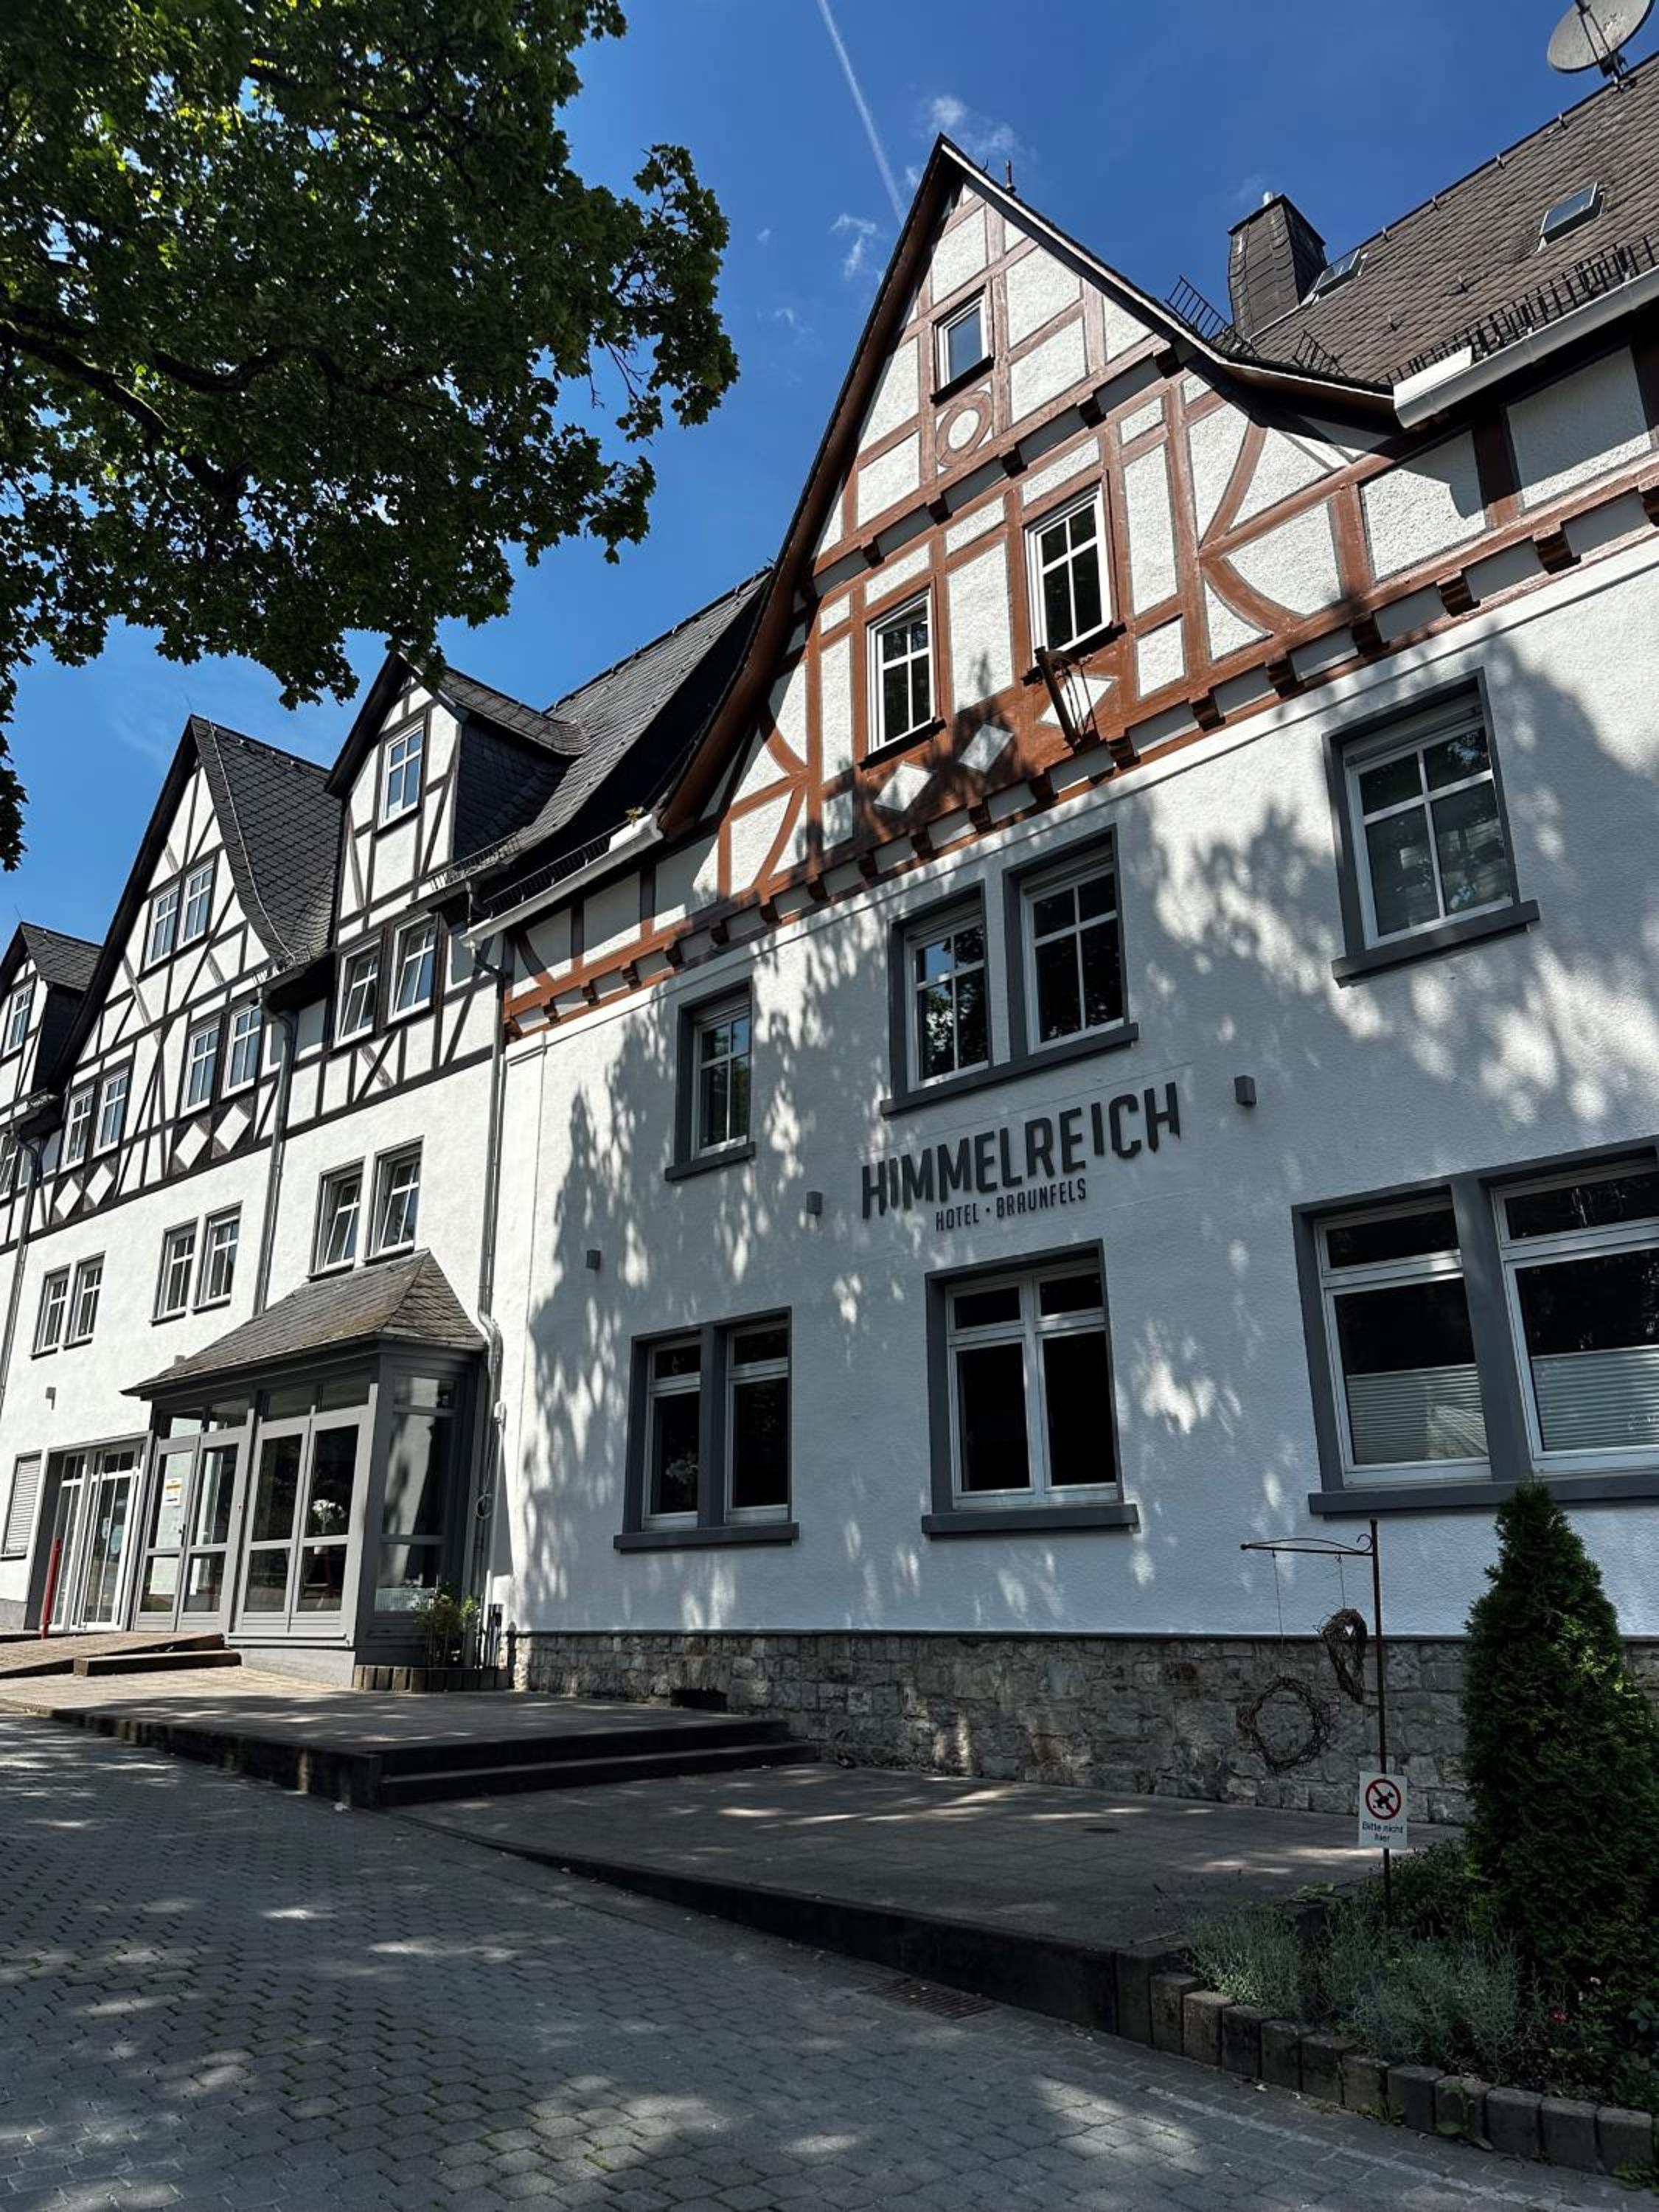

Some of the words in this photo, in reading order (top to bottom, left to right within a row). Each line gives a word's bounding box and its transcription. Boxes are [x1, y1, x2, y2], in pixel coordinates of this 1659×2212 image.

[861, 1082, 1180, 1220] HIMMELREICH
[936, 1203, 979, 1231] HOTEL
[996, 1178, 1086, 1219] BRAUNFELS
[1362, 1820, 1381, 1832] Bitte
[1382, 1823, 1403, 1834] nicht
